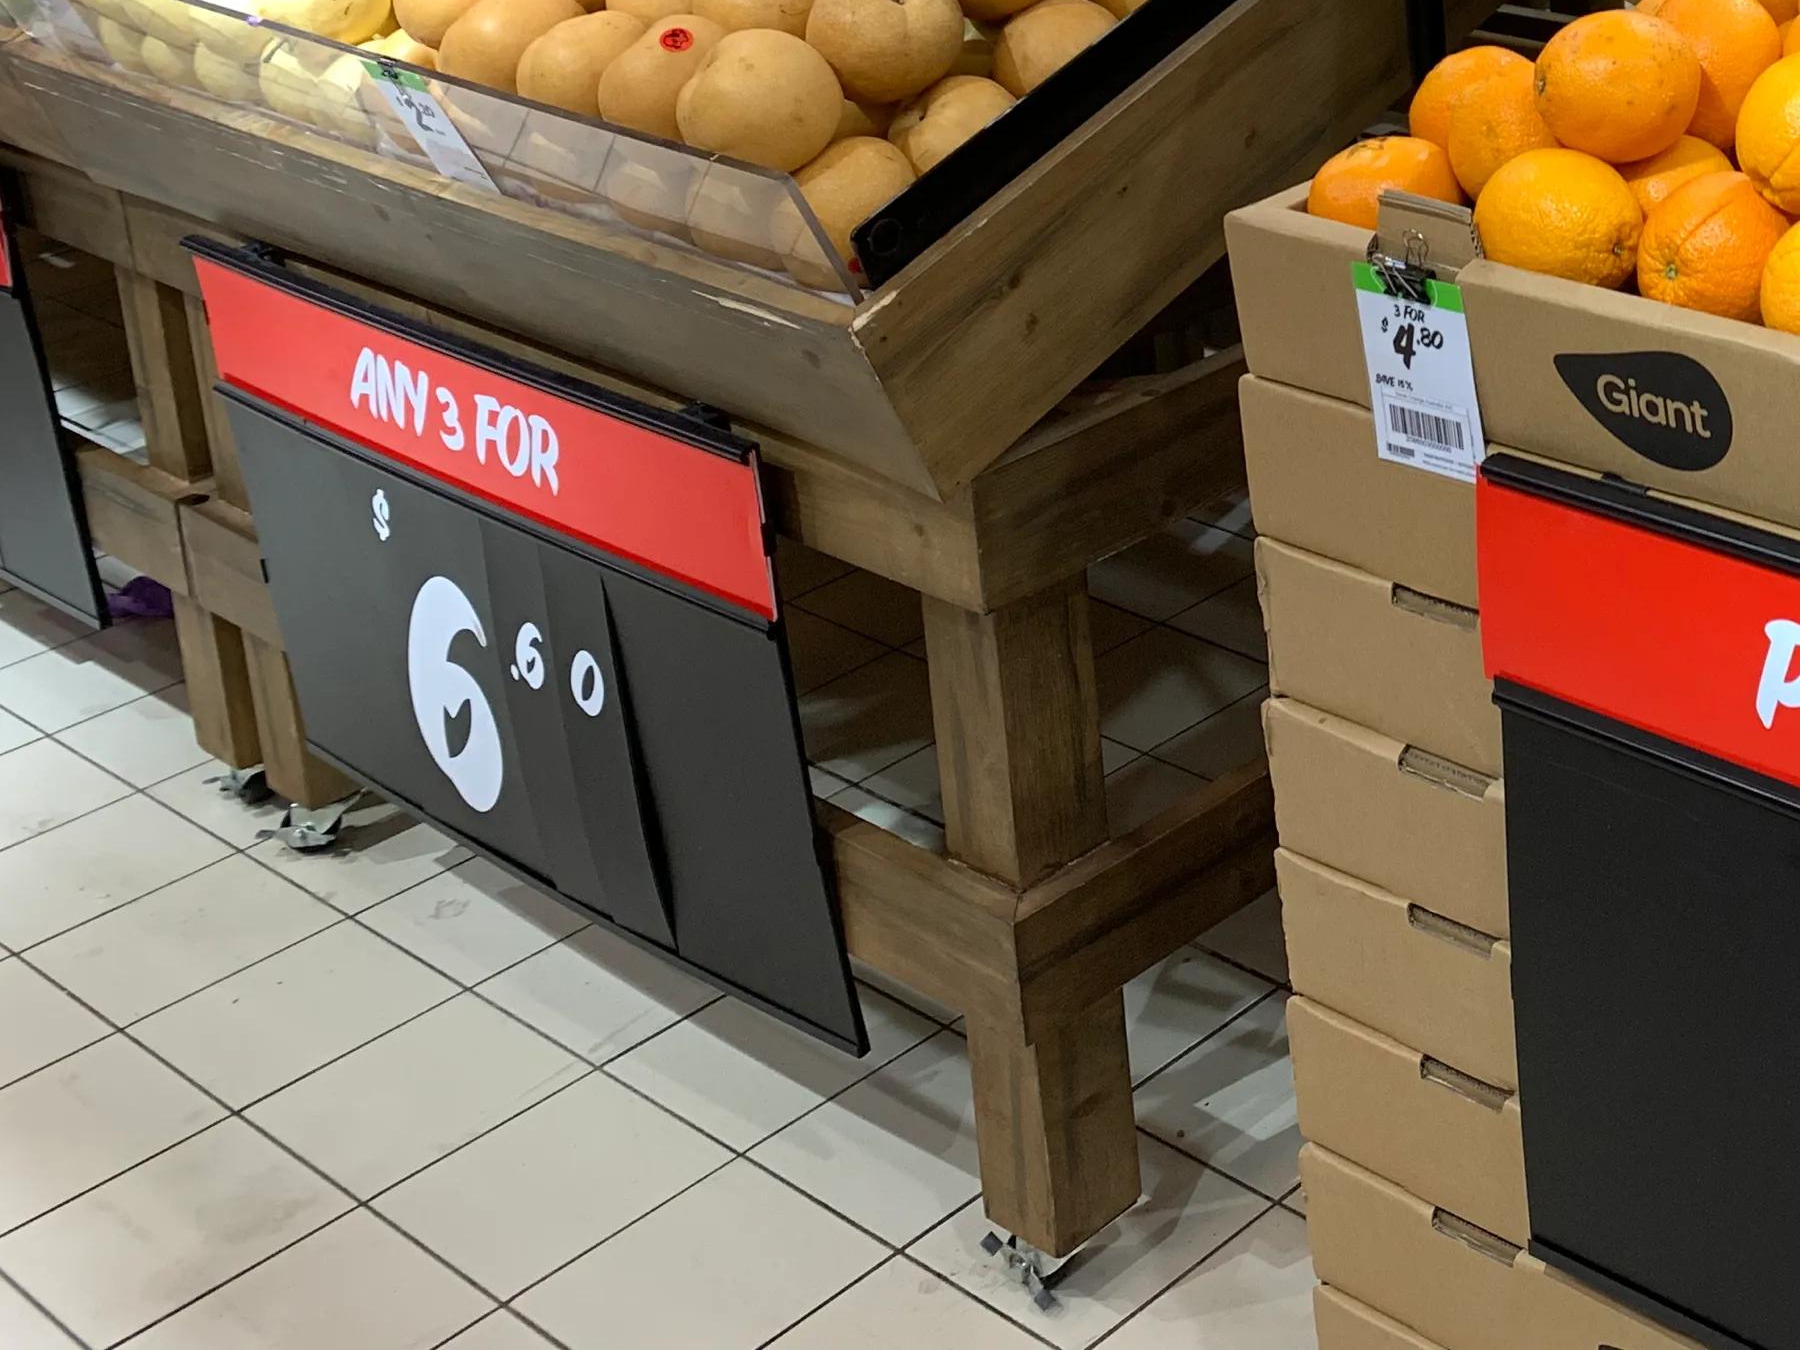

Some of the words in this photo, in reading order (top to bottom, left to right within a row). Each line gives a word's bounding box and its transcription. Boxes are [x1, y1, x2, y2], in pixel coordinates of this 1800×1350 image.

[1403, 305, 1425, 324] FOR
[349, 346, 429, 438] ANY
[438, 386, 465, 452] 3
[475, 393, 561, 496] FOR
[1596, 373, 1712, 438] Giant
[371, 488, 392, 543] $
